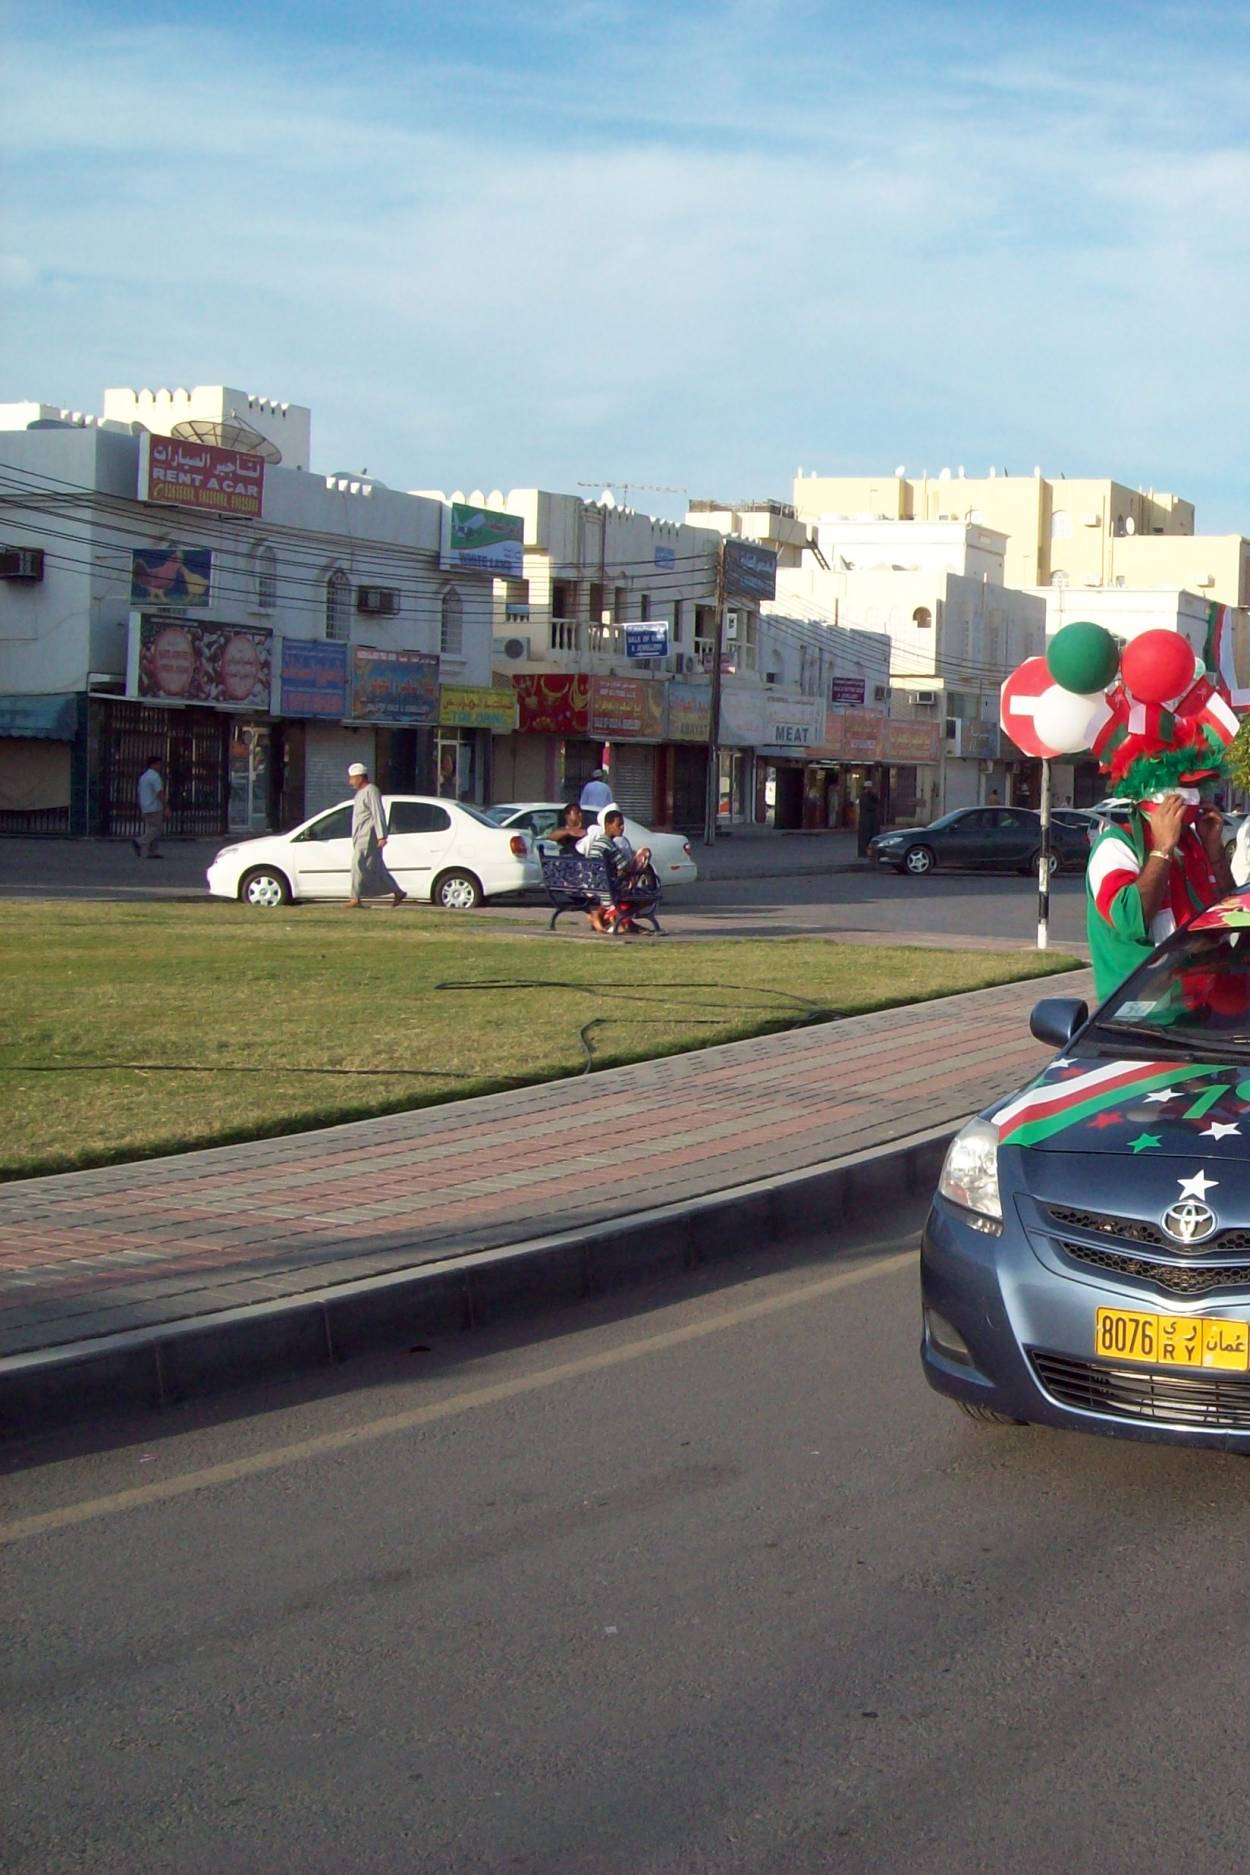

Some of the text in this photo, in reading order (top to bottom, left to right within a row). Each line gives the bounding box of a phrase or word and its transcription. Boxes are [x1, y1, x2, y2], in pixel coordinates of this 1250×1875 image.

[153, 467, 203, 486] RENT
[207, 477, 220, 491] A
[222, 480, 258, 497] CAR
[775, 726, 809, 744] MEAT
[1102, 1315, 1154, 1355] 8076
[1163, 1344, 1196, 1361] R Y
